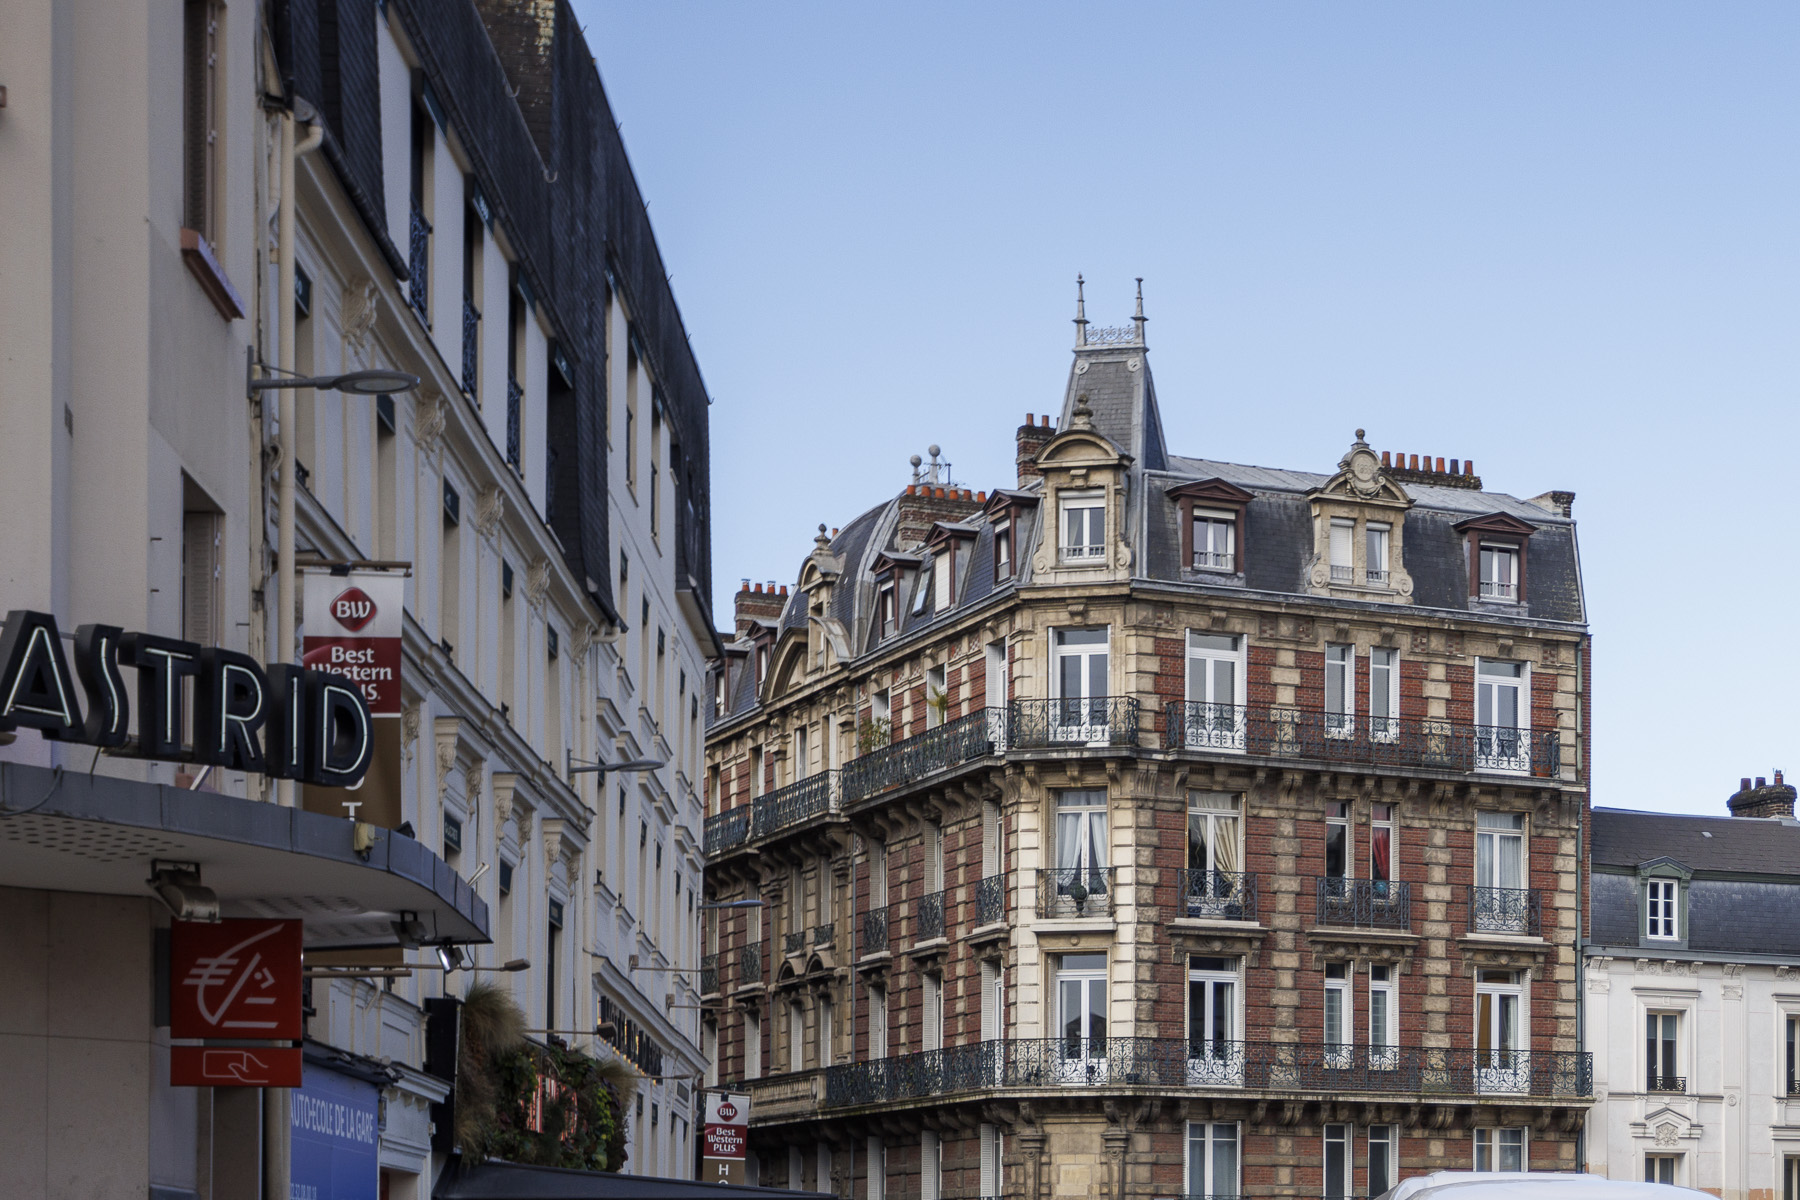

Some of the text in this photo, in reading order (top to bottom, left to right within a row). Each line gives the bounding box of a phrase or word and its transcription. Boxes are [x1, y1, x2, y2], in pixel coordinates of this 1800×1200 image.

[336, 601, 371, 618] BW
[331, 646, 375, 664] Best
[0, 611, 374, 787] ASTRID
[719, 1107, 736, 1117] BW
[335, 1104, 345, 1138] DE
[346, 1106, 356, 1140] LA
[355, 1110, 374, 1145] GARE
[716, 1127, 736, 1136] Best
[707, 1134, 743, 1144] Western
